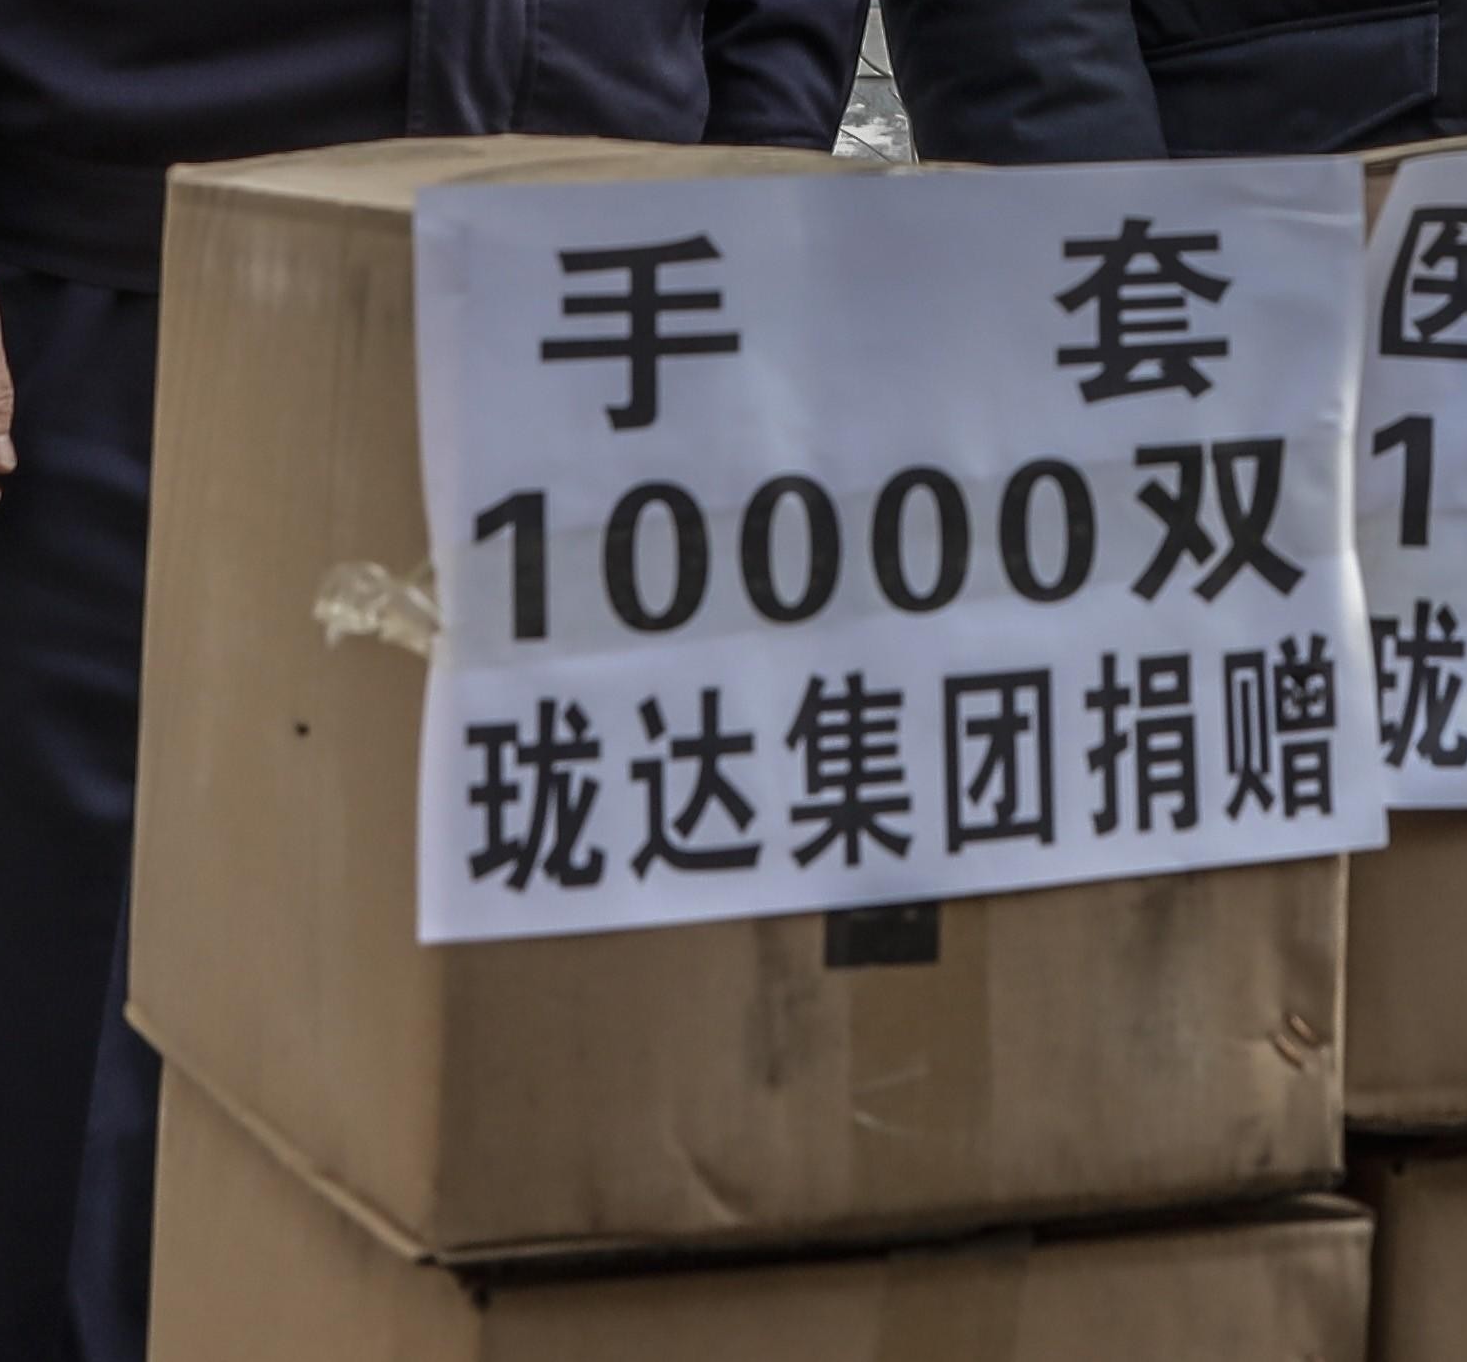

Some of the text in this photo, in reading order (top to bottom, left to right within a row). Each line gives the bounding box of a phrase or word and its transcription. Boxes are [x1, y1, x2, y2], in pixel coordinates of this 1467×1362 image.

[472, 437, 1304, 641] 10000双
[464, 633, 1336, 893] 珑达集团捐赠
